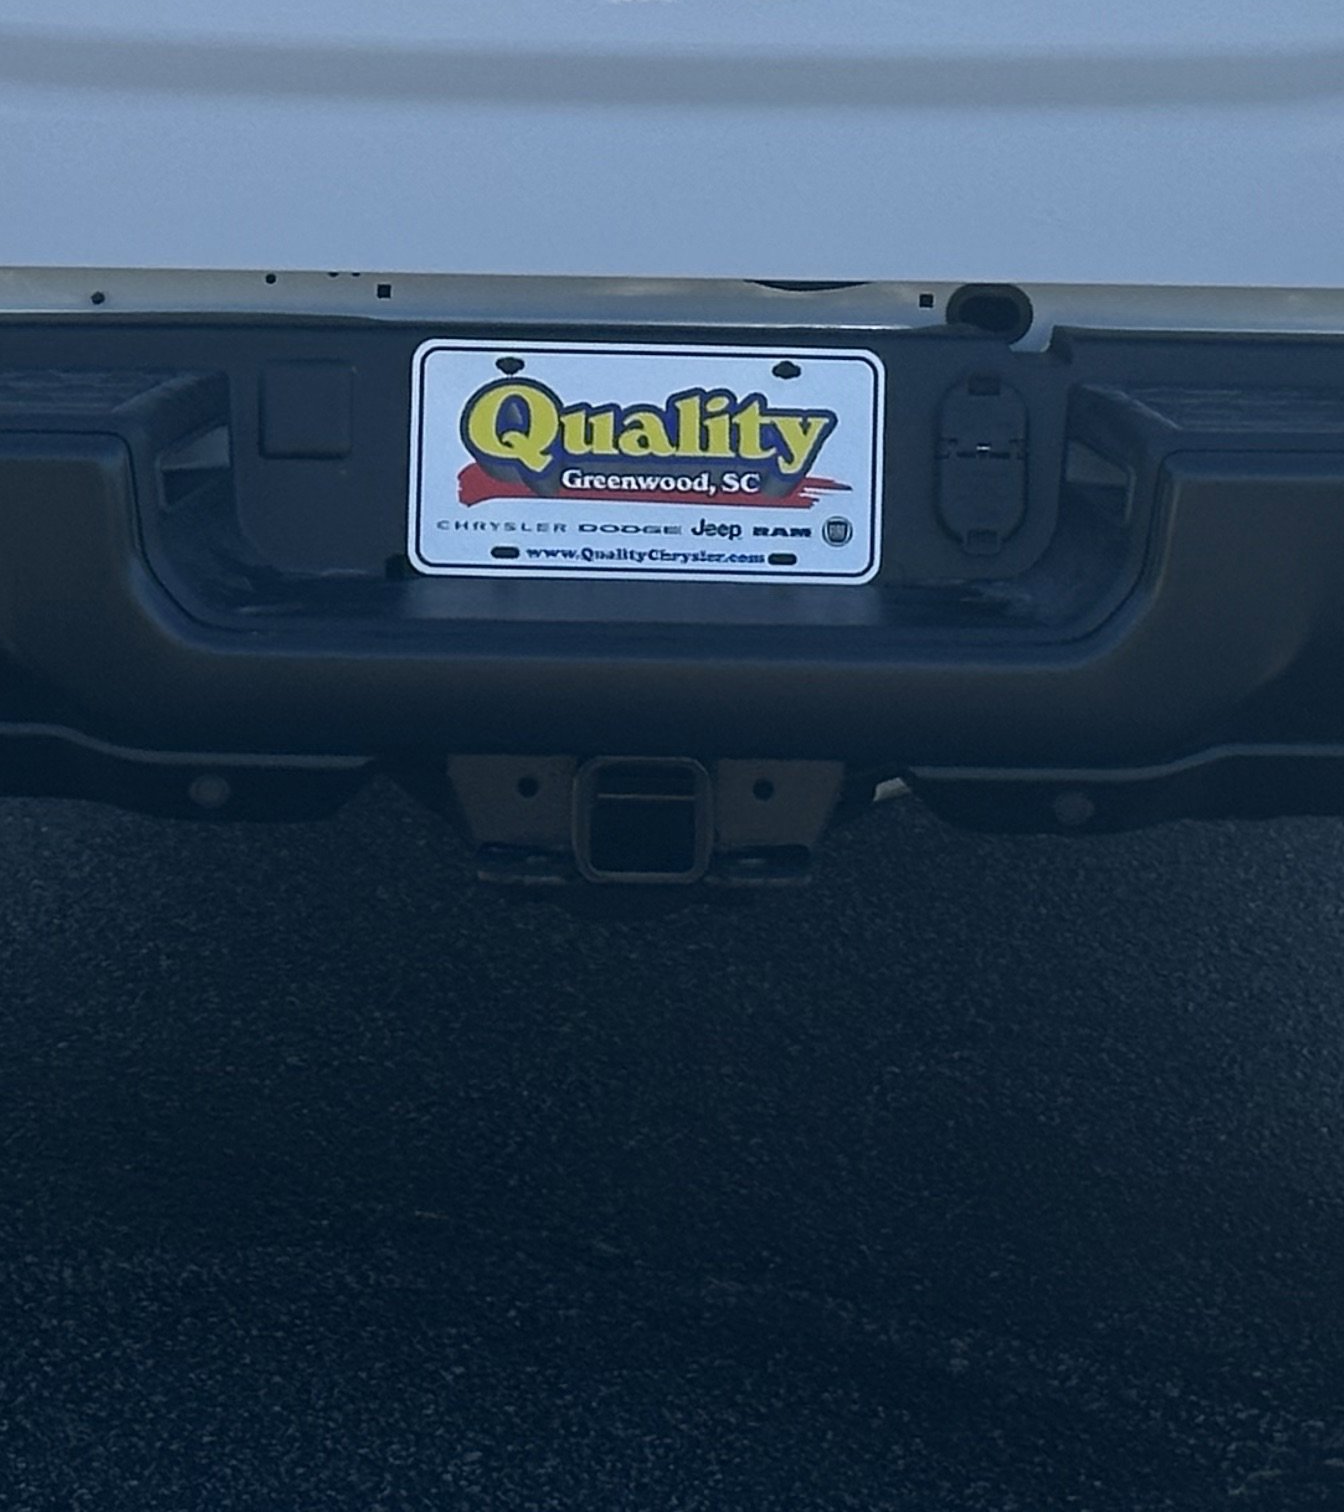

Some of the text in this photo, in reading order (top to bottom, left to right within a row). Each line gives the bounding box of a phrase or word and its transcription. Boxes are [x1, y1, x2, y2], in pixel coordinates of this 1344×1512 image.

[465, 381, 832, 474] Quality
[561, 469, 761, 496] Greenwood, SC
[436, 520, 567, 533] CHRYSLER
[578, 524, 682, 534] DODGE
[691, 518, 743, 540] Jeep
[752, 526, 813, 538] RAM
[524, 547, 766, 565] www.QualityChrysler.com
